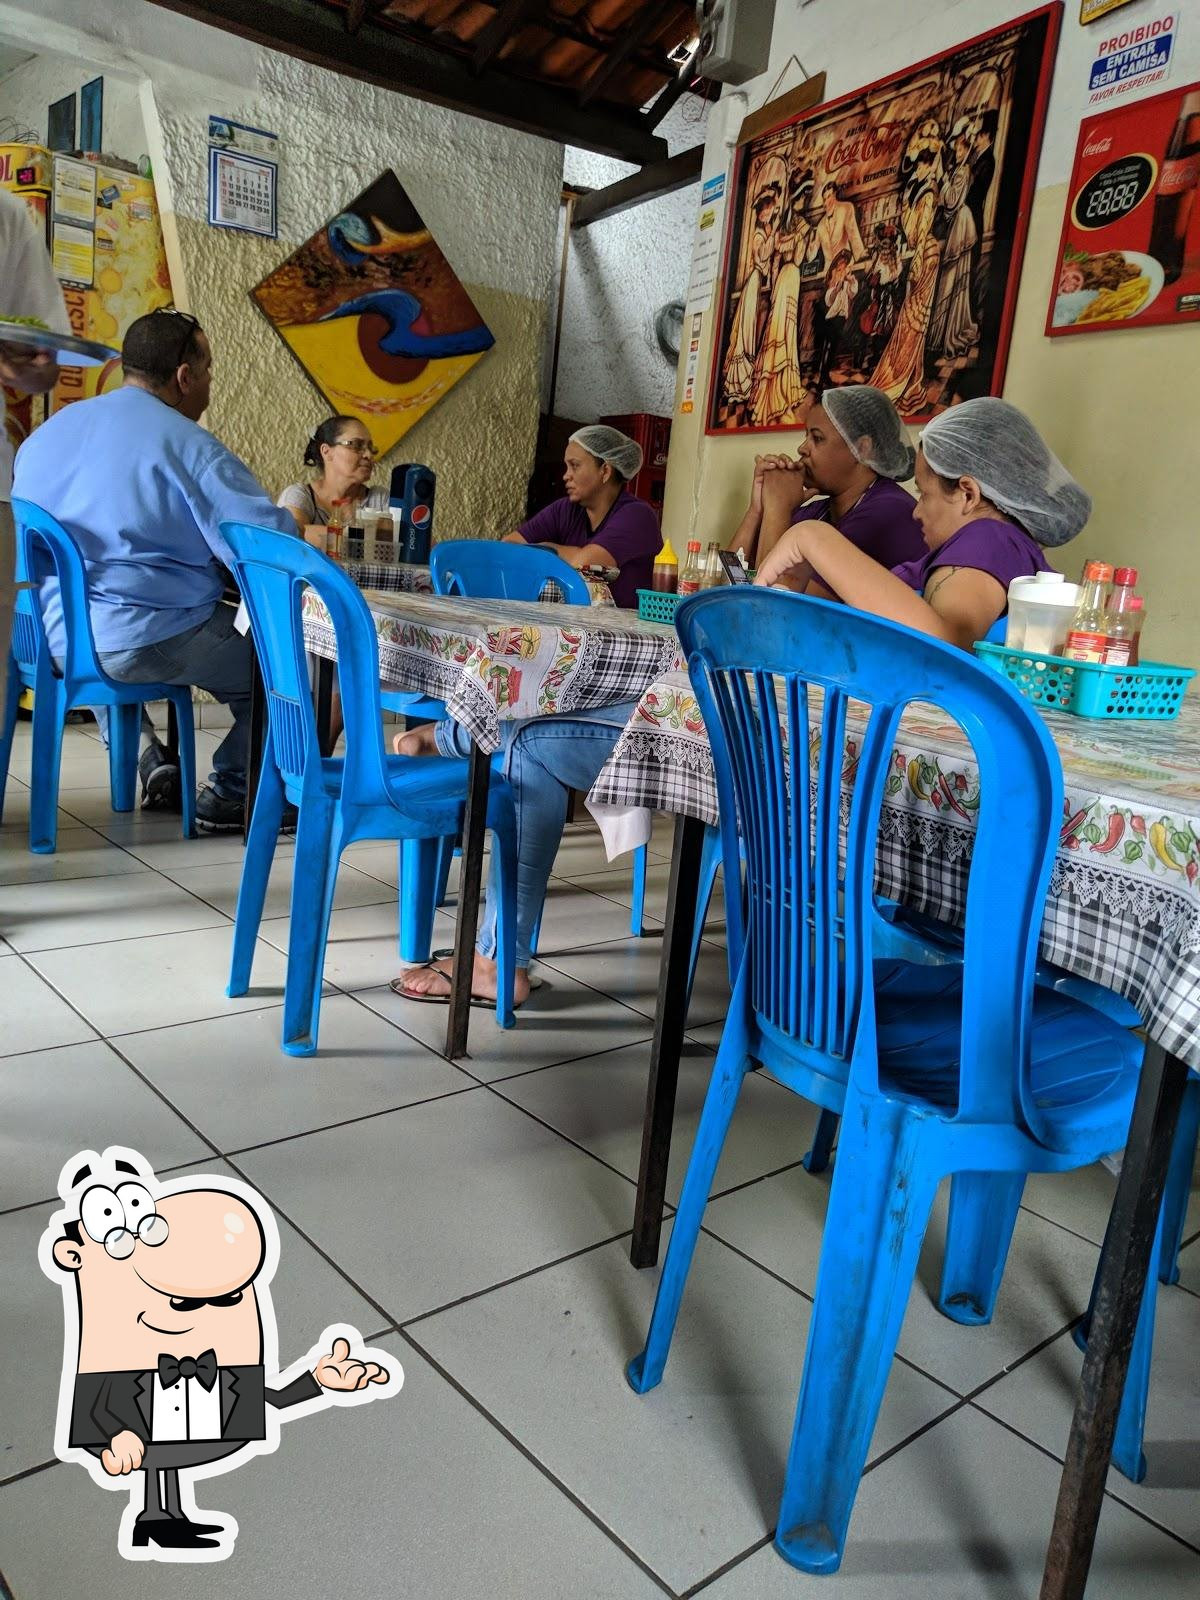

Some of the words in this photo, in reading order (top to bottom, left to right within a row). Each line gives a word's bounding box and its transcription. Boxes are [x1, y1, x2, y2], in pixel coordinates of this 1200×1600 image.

[1098, 16, 1174, 56] PROIBIDO
[1091, 70, 1116, 89] SEM
[1118, 51, 1166, 78] CAMISA
[1106, 41, 1156, 70] ENTRAR
[1088, 87, 1115, 104] FAVOR
[1116, 69, 1165, 95] RESPEITAR!
